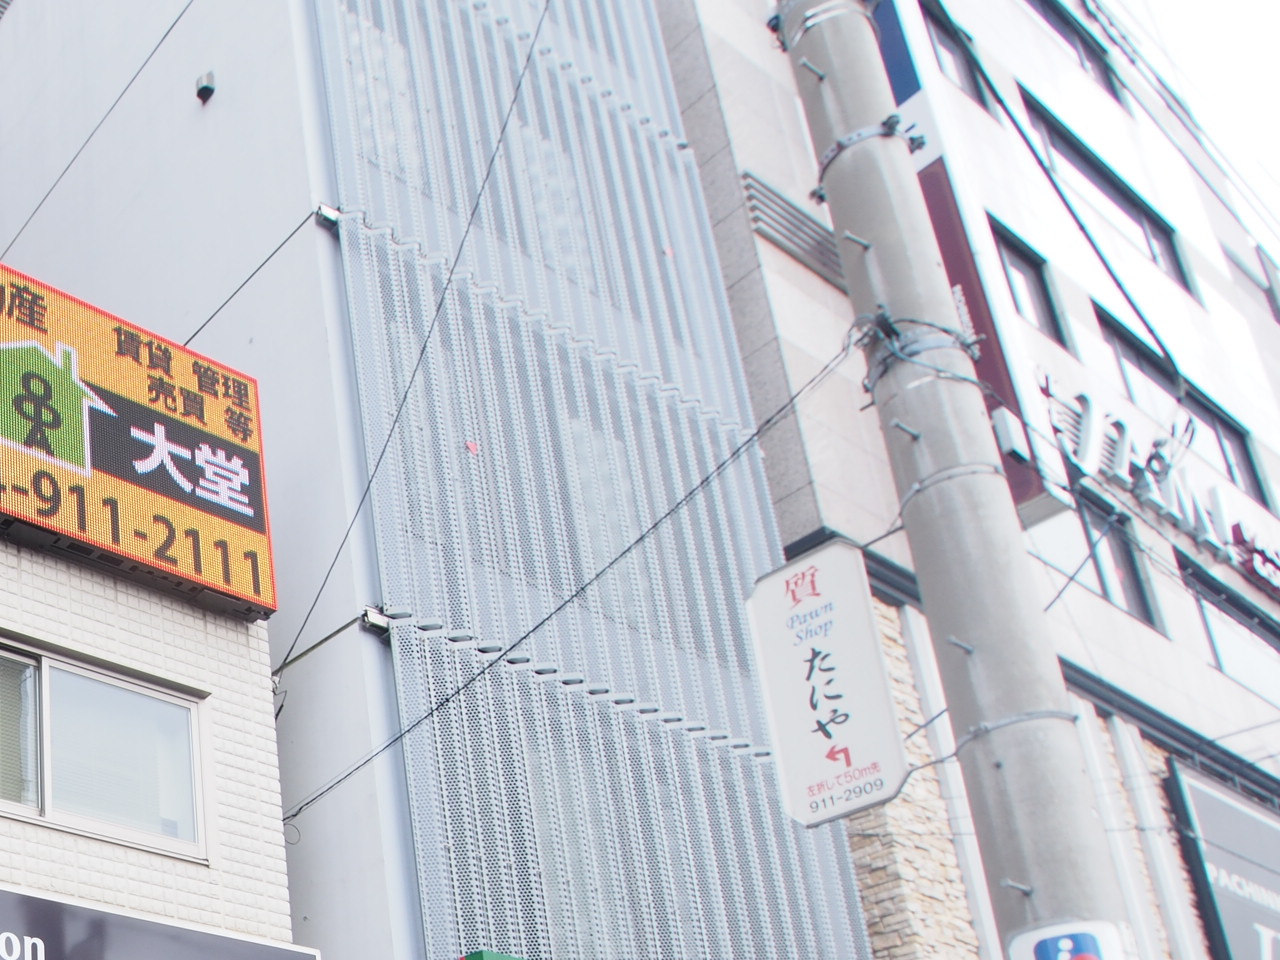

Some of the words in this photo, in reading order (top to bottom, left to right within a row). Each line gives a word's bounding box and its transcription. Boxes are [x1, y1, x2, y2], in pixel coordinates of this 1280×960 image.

[113, 324, 174, 379] 賃貸
[191, 360, 250, 411] 管理
[147, 375, 207, 426] 売買
[224, 406, 253, 444] 等
[130, 421, 254, 517] 大堂
[784, 565, 821, 610] 質
[786, 602, 834, 630] Pawn
[793, 619, 833, 646] Shop
[803, 648, 850, 739] たにや
[807, 762, 882, 798] 左折して50m先
[809, 778, 884, 814] 911-2909
